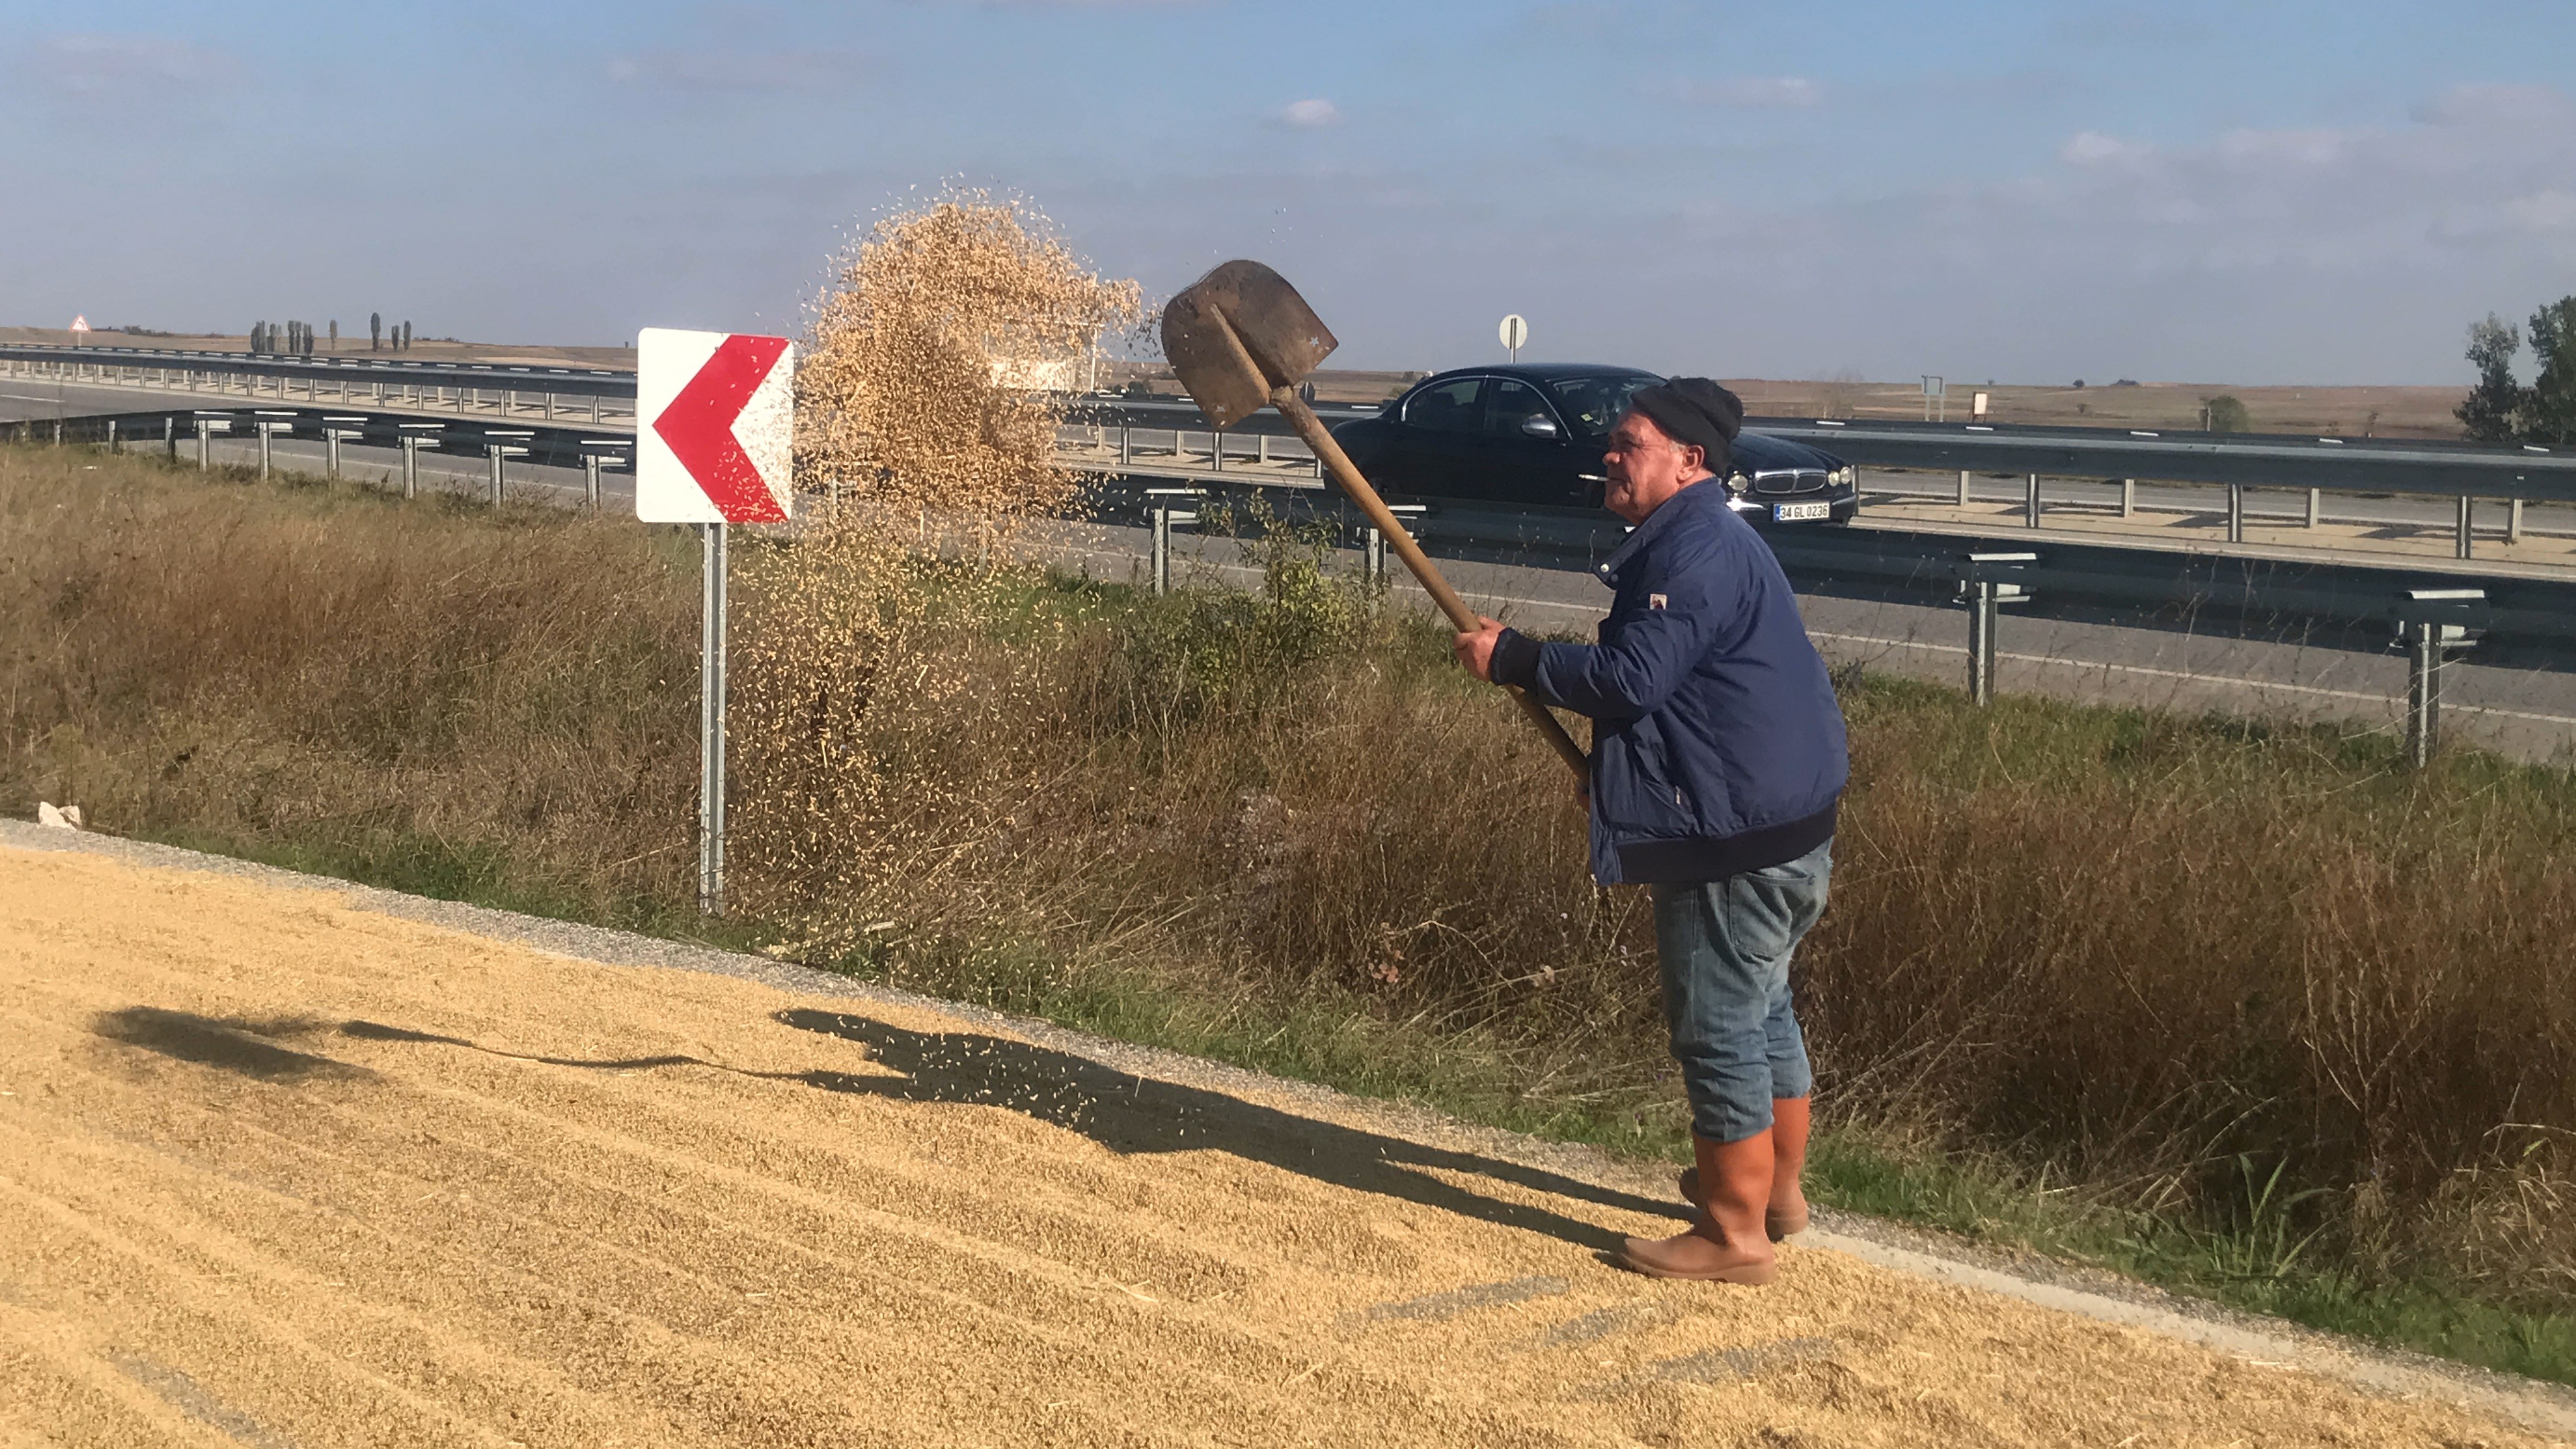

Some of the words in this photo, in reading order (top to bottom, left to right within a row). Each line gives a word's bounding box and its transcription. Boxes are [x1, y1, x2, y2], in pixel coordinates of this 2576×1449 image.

[1780, 506, 1792, 519] 34
[1794, 506, 1805, 517] GL
[1807, 504, 1827, 517] 0236
